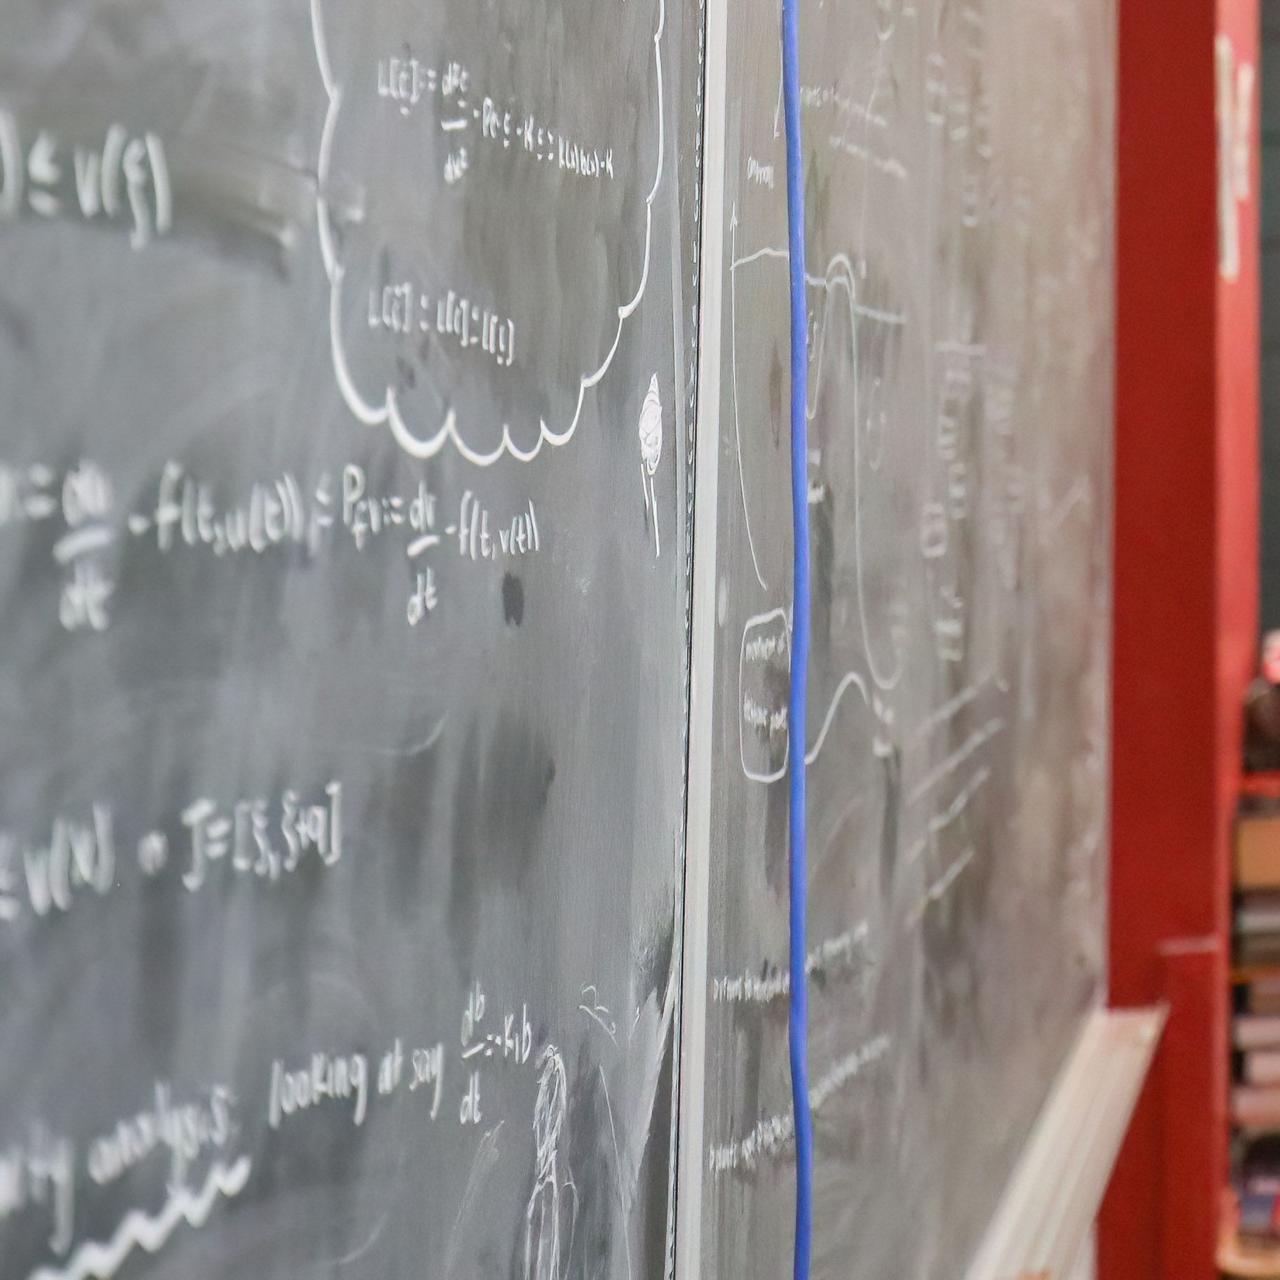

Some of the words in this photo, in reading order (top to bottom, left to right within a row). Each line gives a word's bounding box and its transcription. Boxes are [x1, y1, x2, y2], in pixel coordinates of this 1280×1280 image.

[268, 1053, 368, 1130] looking
[377, 1037, 403, 1096] at
[408, 1041, 444, 1123] say
